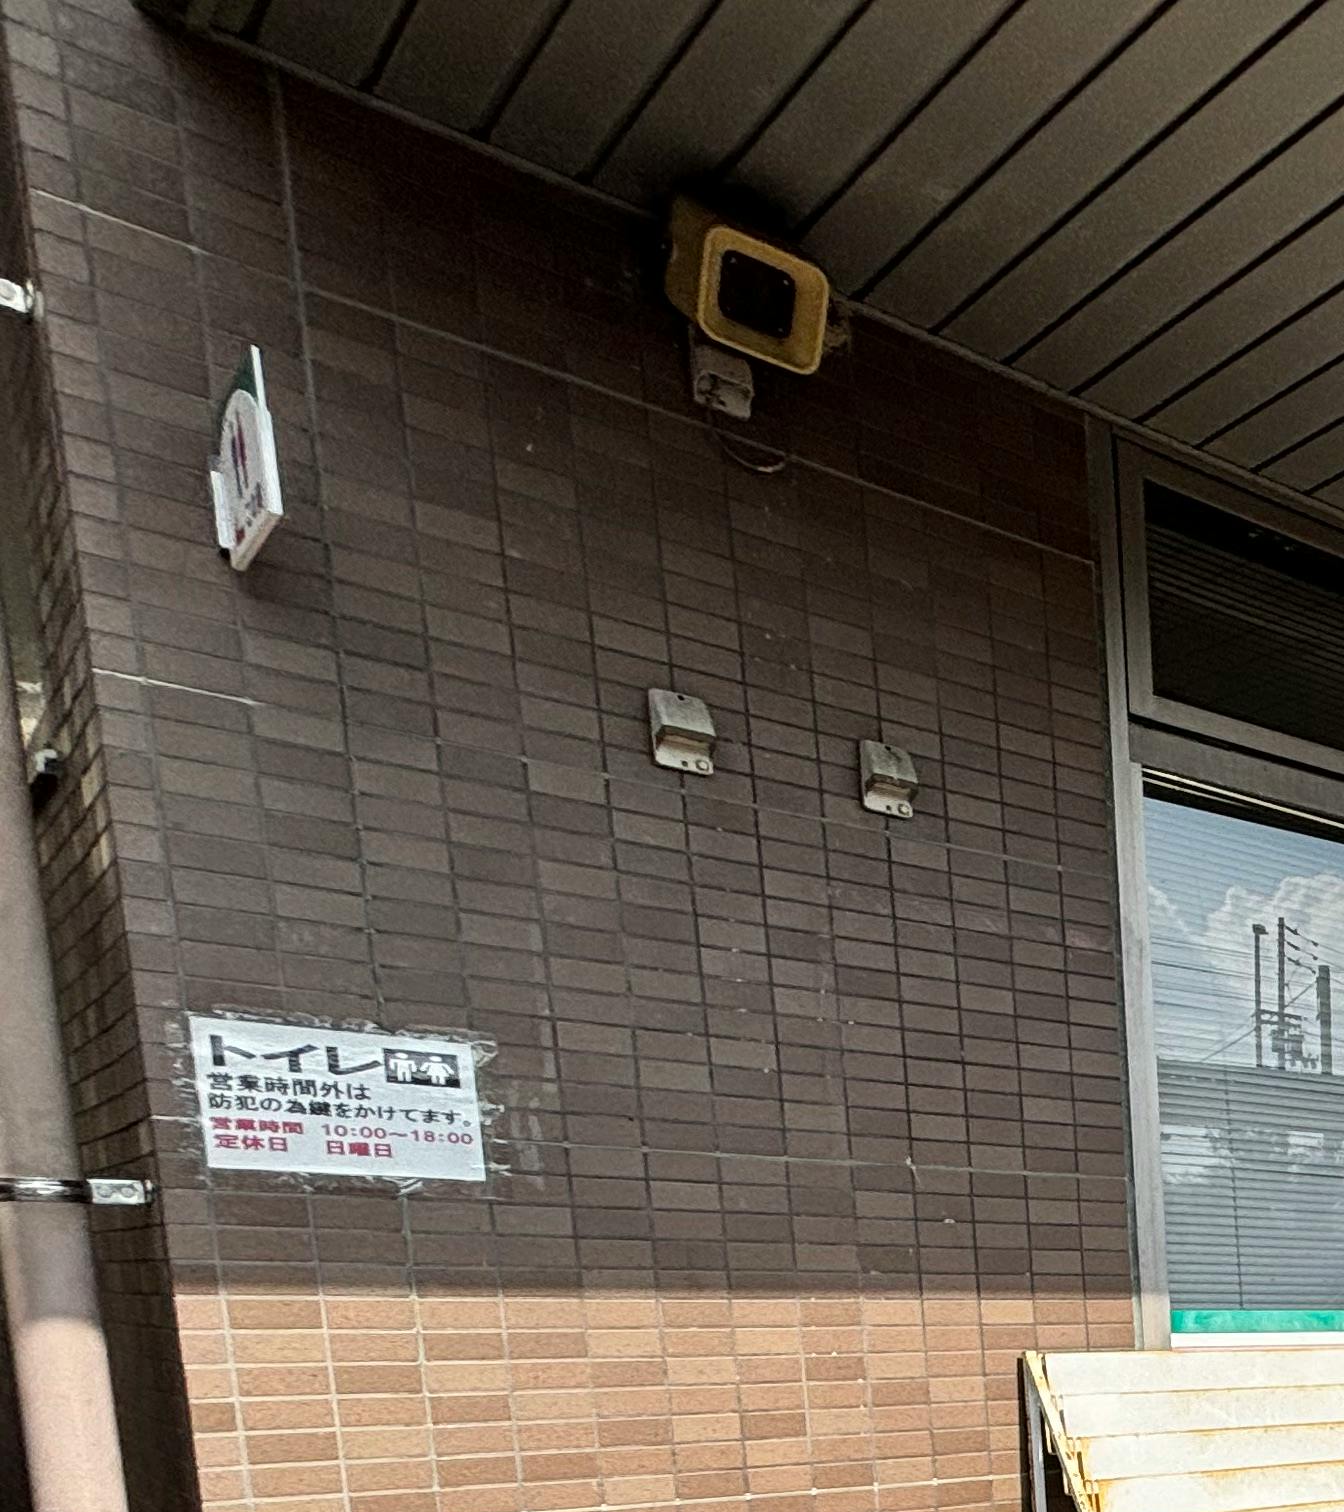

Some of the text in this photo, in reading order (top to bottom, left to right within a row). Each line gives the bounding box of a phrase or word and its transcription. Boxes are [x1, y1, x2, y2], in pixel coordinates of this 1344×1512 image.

[208, 1033, 383, 1076] トイレ
[206, 1071, 372, 1101] 営業時間外は
[208, 1116, 305, 1135] 営業時間
[213, 1134, 393, 1158] 定休日 日曜日
